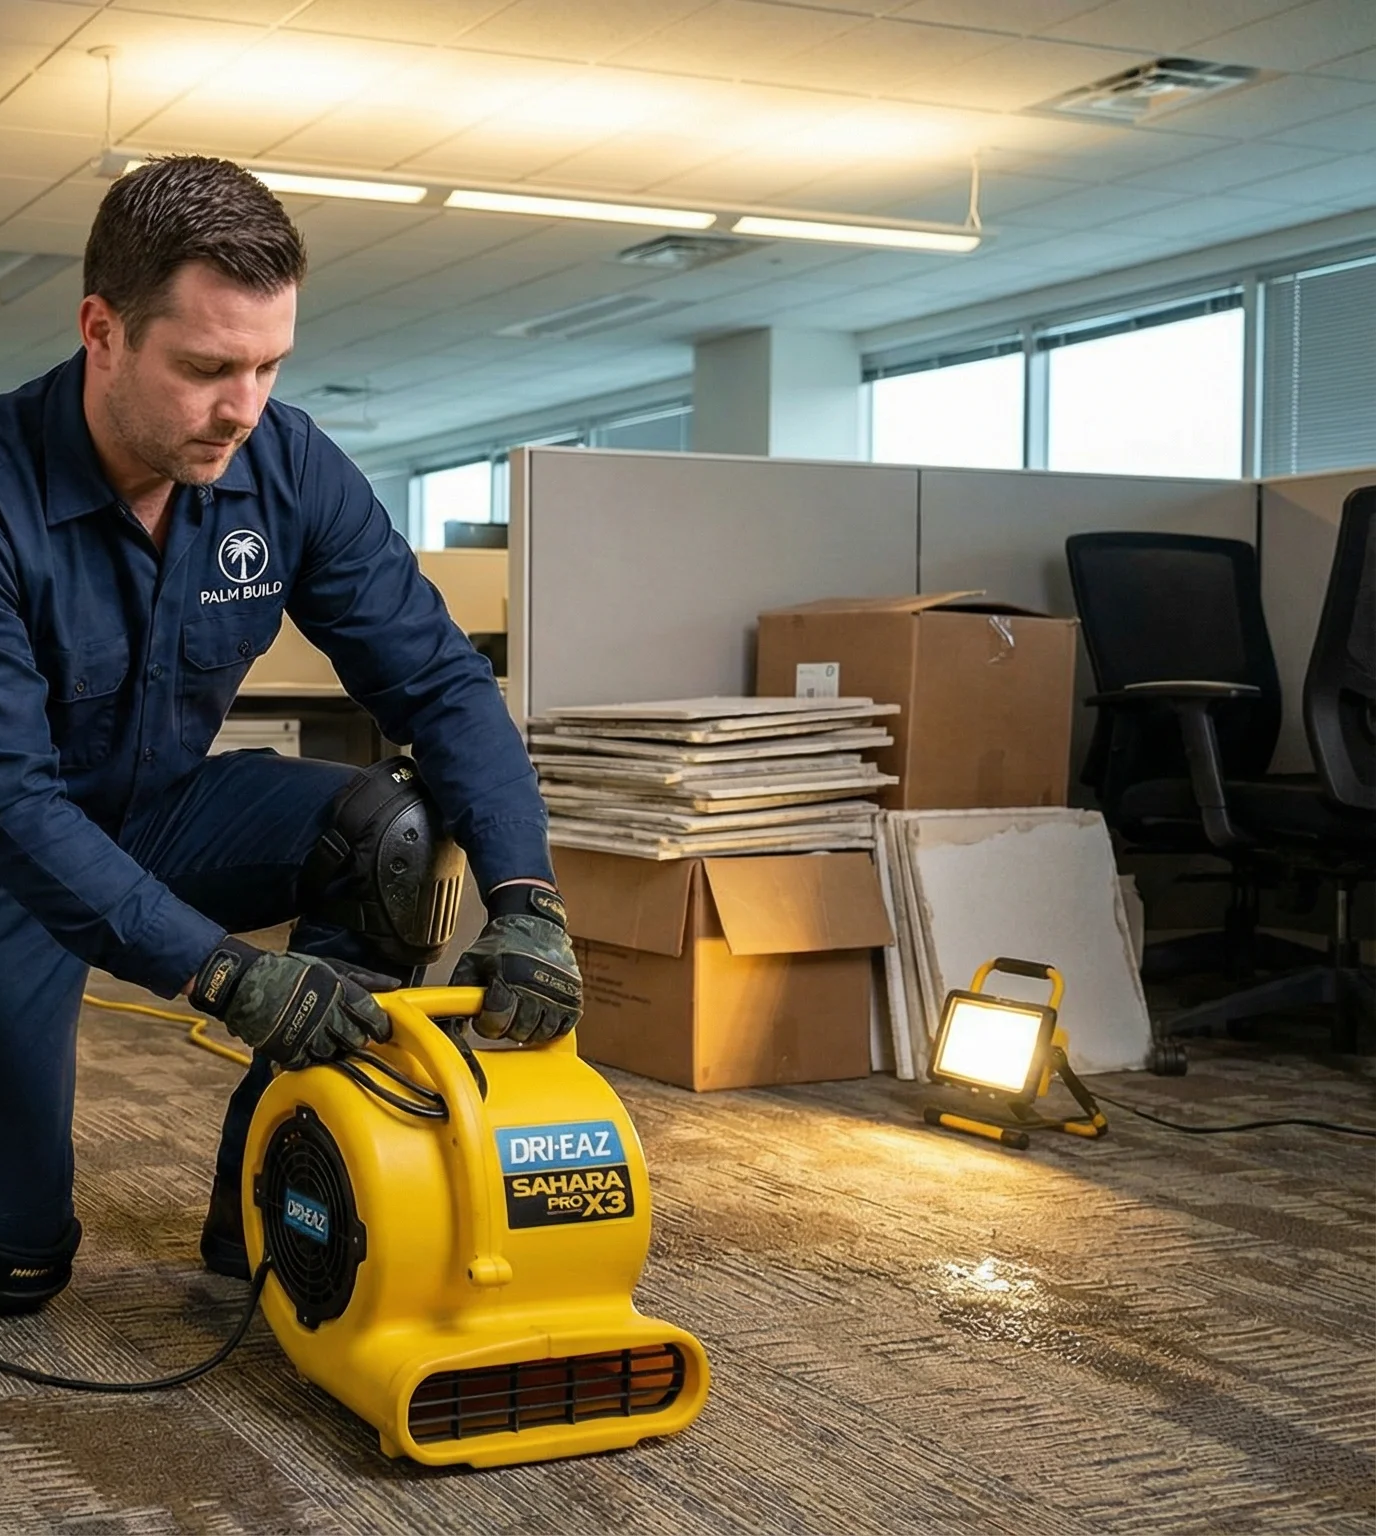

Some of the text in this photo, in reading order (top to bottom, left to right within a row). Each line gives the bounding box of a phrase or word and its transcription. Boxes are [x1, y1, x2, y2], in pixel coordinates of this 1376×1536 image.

[200, 581, 283, 605] PALM BUILD
[512, 1170, 626, 1198] SAHARA
[547, 1190, 627, 1217] PRO X3
